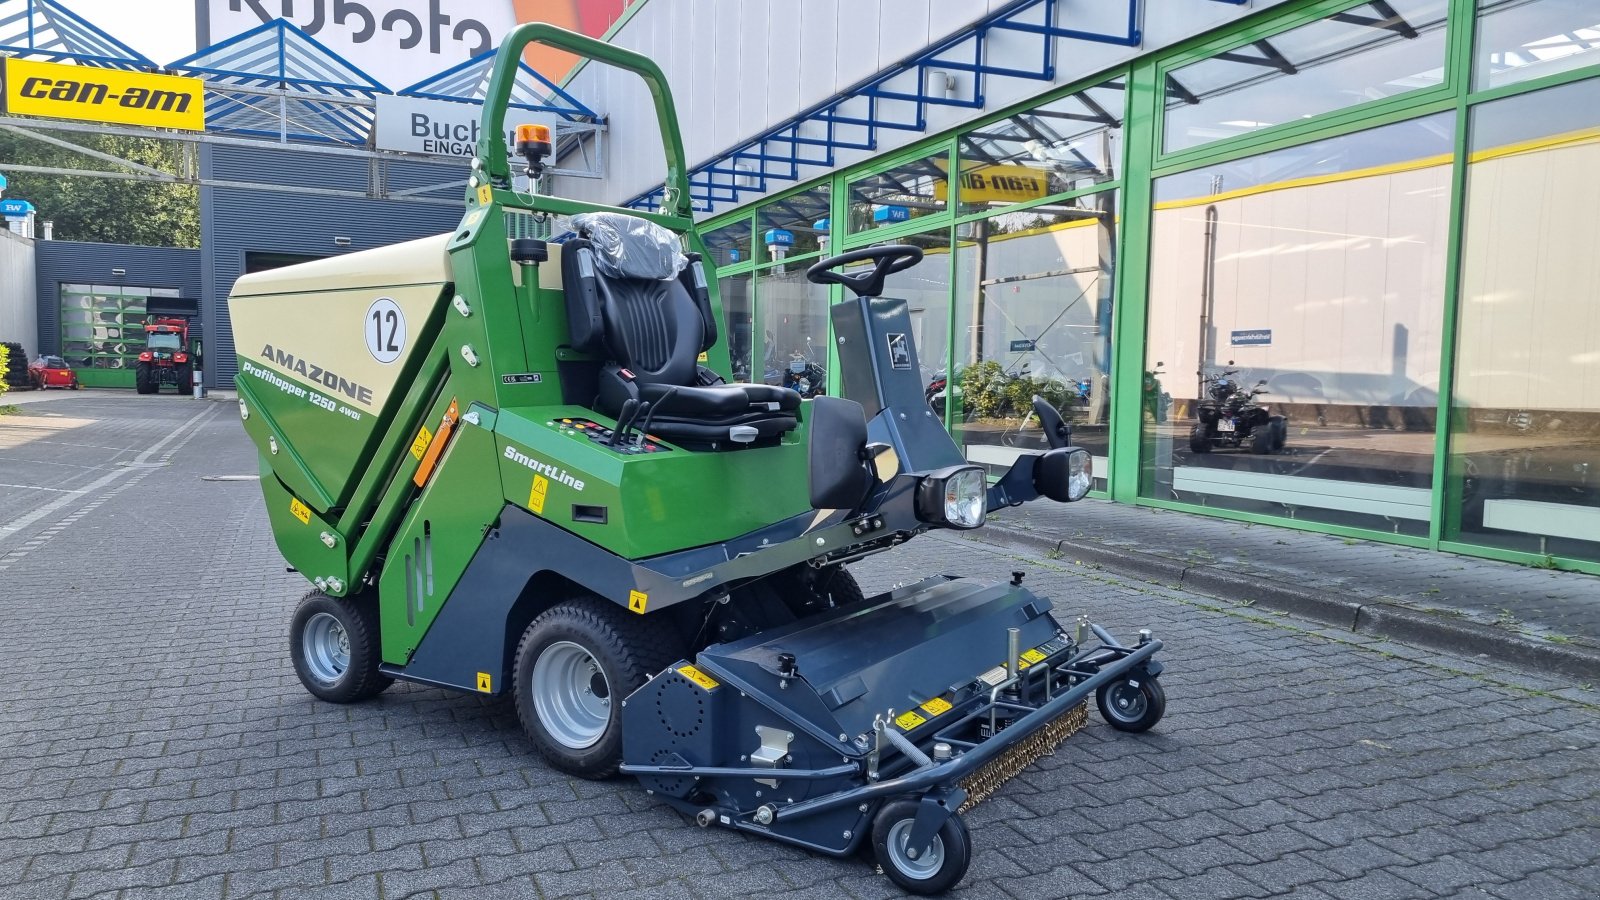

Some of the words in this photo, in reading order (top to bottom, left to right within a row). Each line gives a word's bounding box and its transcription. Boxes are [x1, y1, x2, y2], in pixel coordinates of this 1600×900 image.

[20, 77, 192, 113] can-am
[411, 112, 517, 147] Buchr
[373, 310, 399, 351] 12
[243, 361, 307, 399] Profihopper
[309, 391, 337, 412] 1250
[260, 344, 373, 406] AMAZONE
[504, 445, 585, 491] SmartLine
